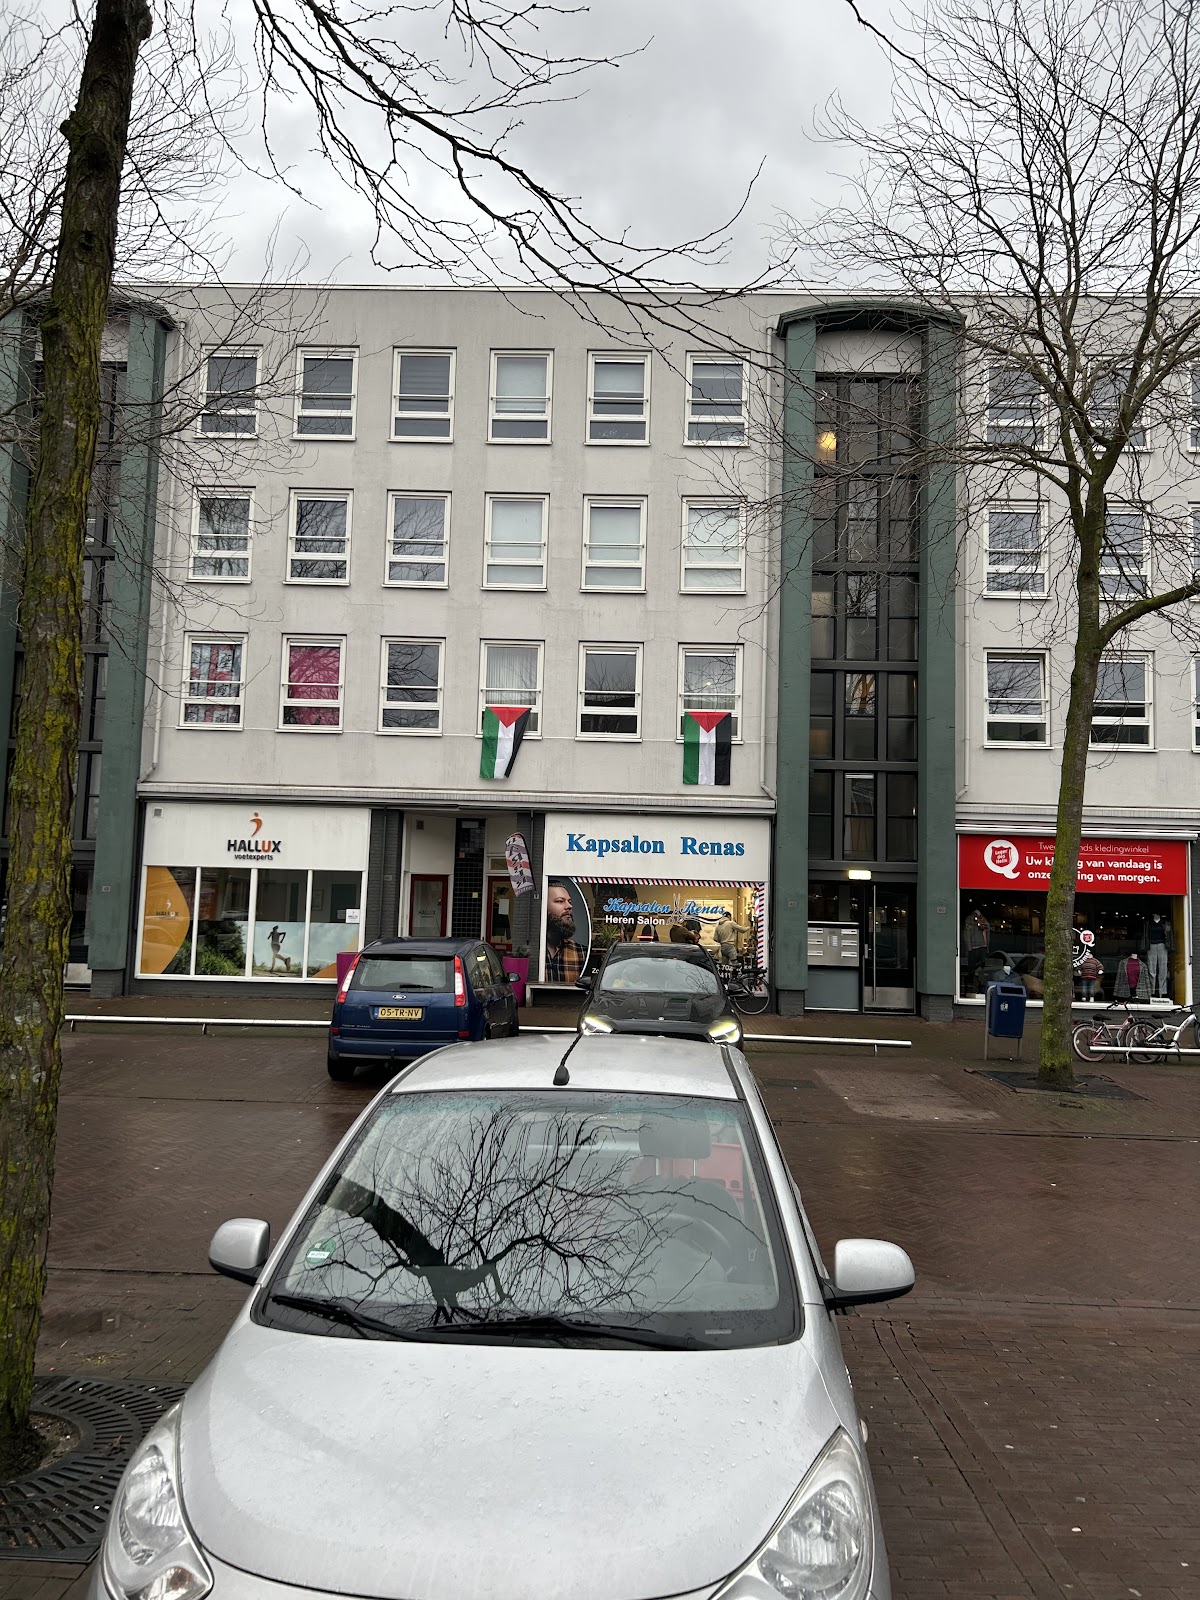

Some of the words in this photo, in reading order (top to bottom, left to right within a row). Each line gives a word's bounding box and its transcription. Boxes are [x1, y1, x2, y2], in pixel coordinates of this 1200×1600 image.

[227, 839, 281, 852] HALLUX
[566, 834, 665, 857] Kapsalon
[680, 837, 745, 856] Renas
[1095, 844, 1149, 854] kledingwinkel
[1025, 856, 1042, 866] Uw
[1107, 859, 1151, 871] vandaag
[1154, 860, 1163, 870] is
[1118, 874, 1160, 884] morgen.
[603, 898, 671, 916] Kapsalon
[680, 901, 725, 915] Renas
[605, 915, 634, 925] Heren
[637, 916, 665, 926] Salon
[380, 1008, 420, 1017] 05-TR-NV
